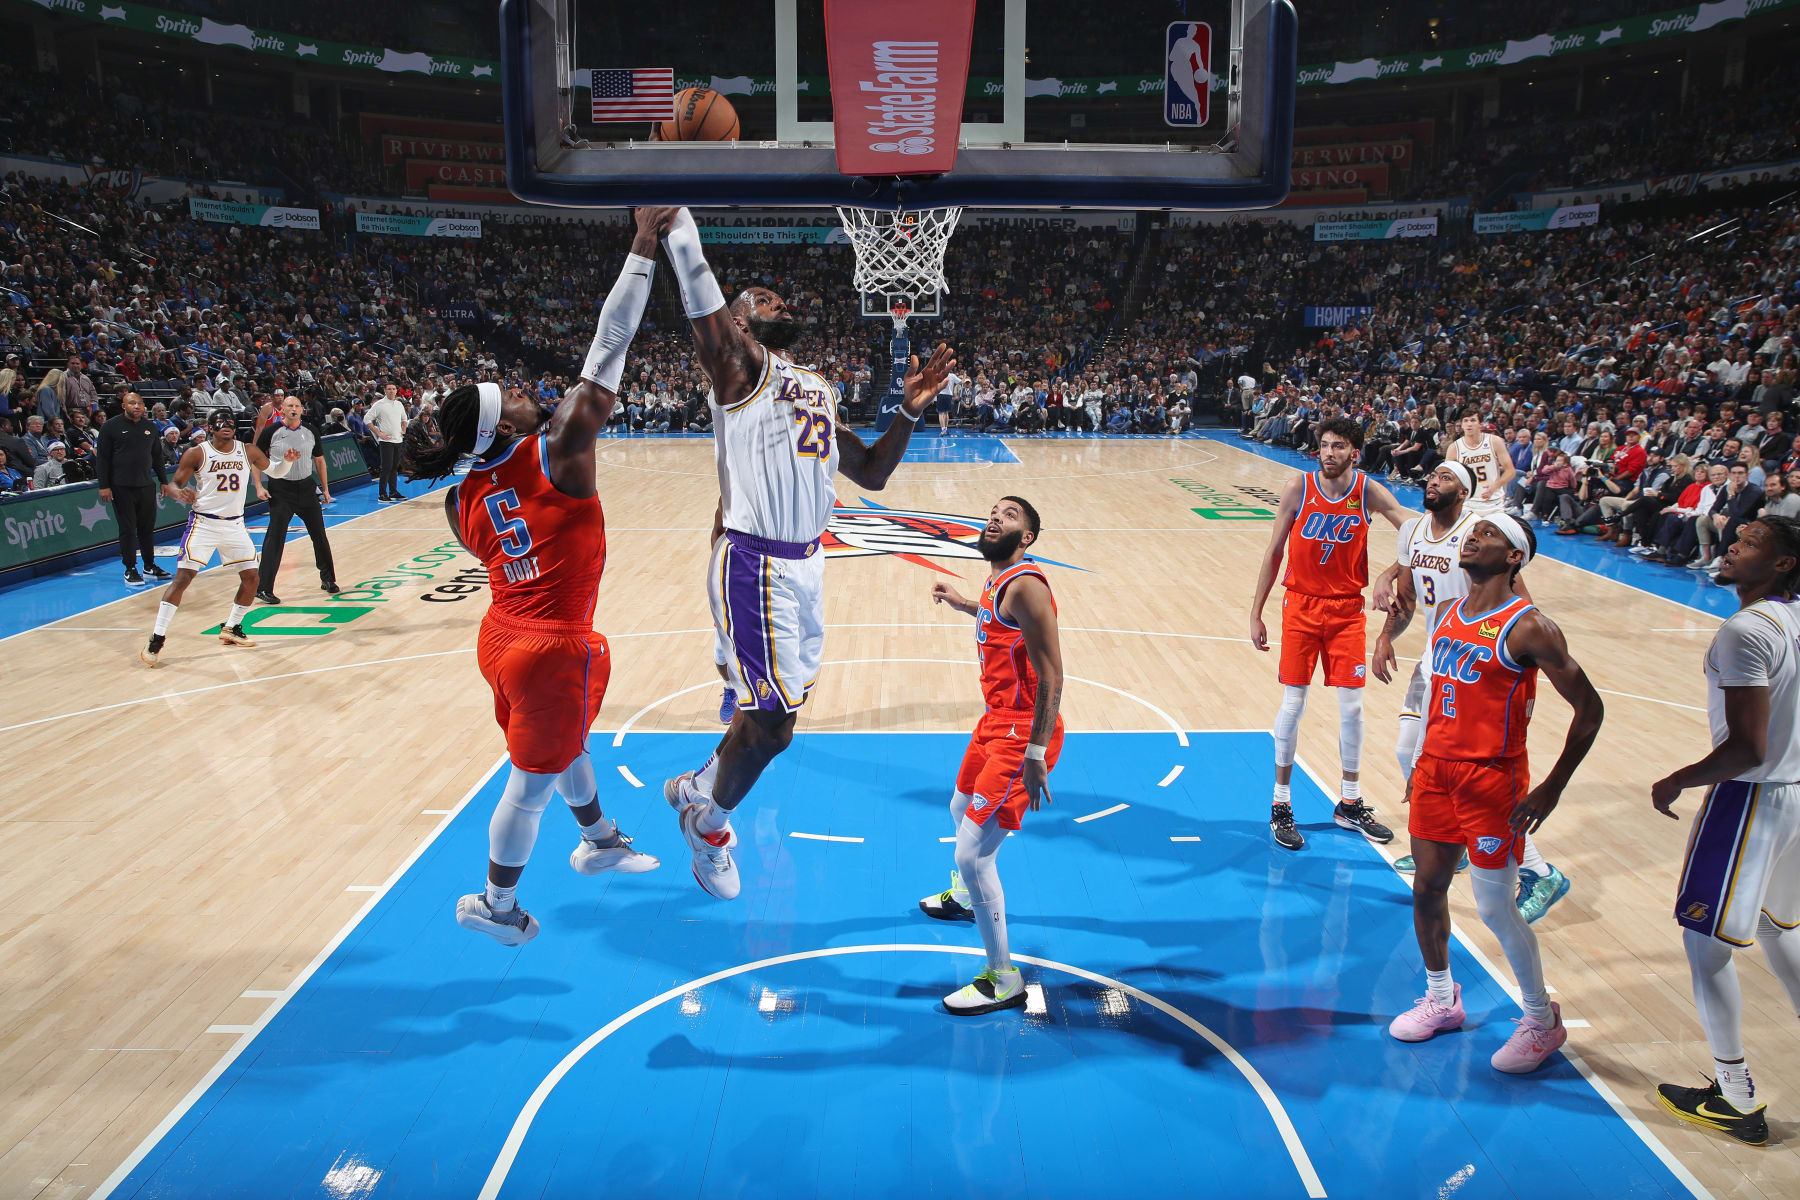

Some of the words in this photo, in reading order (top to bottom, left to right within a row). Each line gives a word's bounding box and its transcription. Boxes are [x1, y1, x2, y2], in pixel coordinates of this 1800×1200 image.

[155, 15, 199, 34] Sprite
[1648, 14, 1695, 36] Sprite
[249, 33, 285, 51] Sprite
[1549, 34, 1585, 52] Sprite
[342, 50, 382, 66] Sprite
[1466, 49, 1502, 67] Sprite
[427, 60, 461, 74] Sprite
[1297, 67, 1332, 84] Sprite
[1376, 60, 1409, 75] Sprite
[1057, 83, 1088, 96] Sprite
[1171, 104, 1192, 119] NBA
[390, 140, 505, 160] RIVERWI
[1294, 145, 1406, 164] ERWIND
[439, 166, 507, 182] CASIN
[1291, 169, 1358, 186] SINO
[194, 201, 221, 210] Internet
[223, 204, 255, 214] Shouldn't
[206, 212, 219, 220] This
[1569, 210, 1597, 220] Dobson
[285, 213, 317, 222] Dobson
[360, 215, 387, 223] Internet
[389, 217, 421, 225] Shouldn't
[449, 223, 479, 232] Dobson
[715, 231, 761, 240] Shouldn't
[777, 231, 796, 240] This
[1320, 223, 1347, 231] Internet
[1407, 222, 1435, 232] Dobson
[441, 309, 475, 318] ULTRA
[794, 406, 832, 463] 23
[208, 460, 244, 473] LAKERS
[330, 447, 357, 471] Sprite
[1462, 454, 1491, 465] LAKERS
[216, 473, 240, 493] 28
[1475, 466, 1488, 484] 5
[5, 510, 66, 549] Sprite
[483, 487, 533, 558] 5
[1301, 512, 1361, 543] OKC
[1320, 543, 1335, 565] 7
[1411, 549, 1452, 574] LAKERS
[502, 556, 541, 583] DORT
[1422, 574, 1437, 608] 3
[1432, 636, 1494, 684] OKC
[1442, 683, 1456, 718] 2
